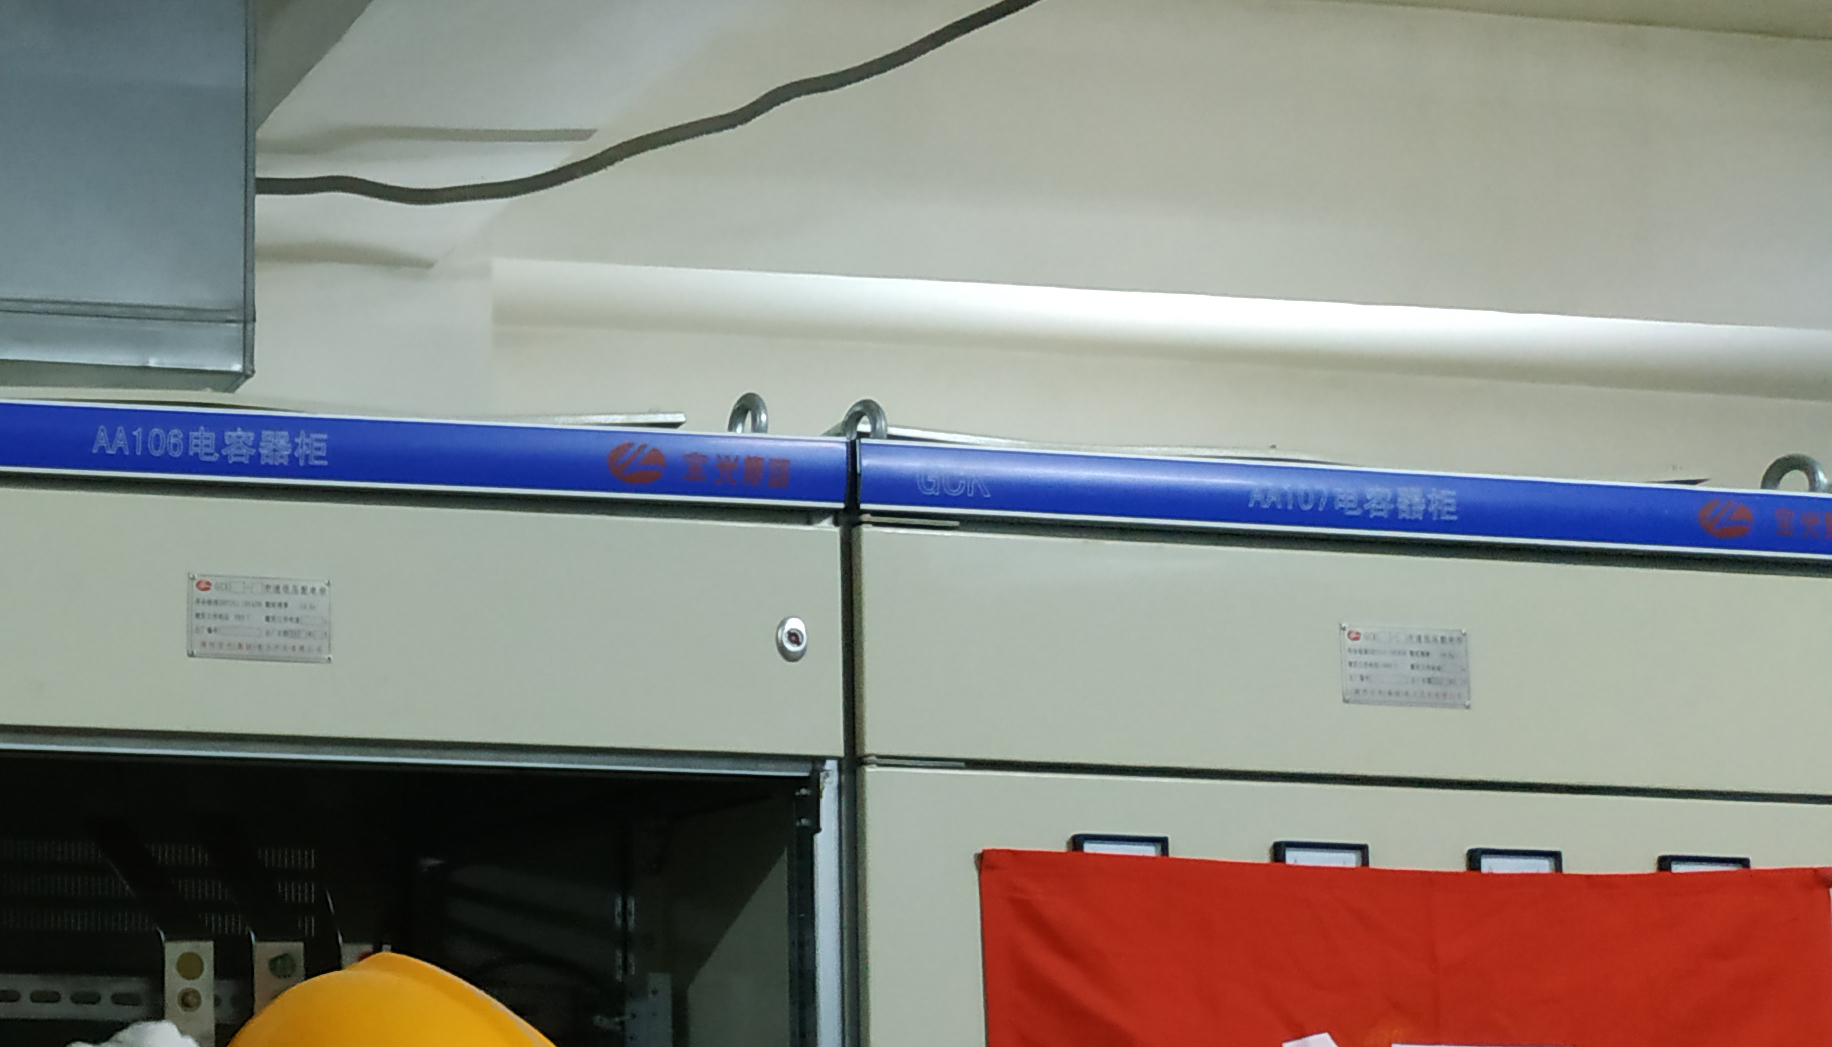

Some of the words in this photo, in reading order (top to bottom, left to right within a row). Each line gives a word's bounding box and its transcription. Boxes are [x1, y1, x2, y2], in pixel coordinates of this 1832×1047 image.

[91, 425, 329, 467] AA106电容器柜
[916, 462, 991, 498] GCK
[1248, 484, 1458, 521] AA107电容器柜
